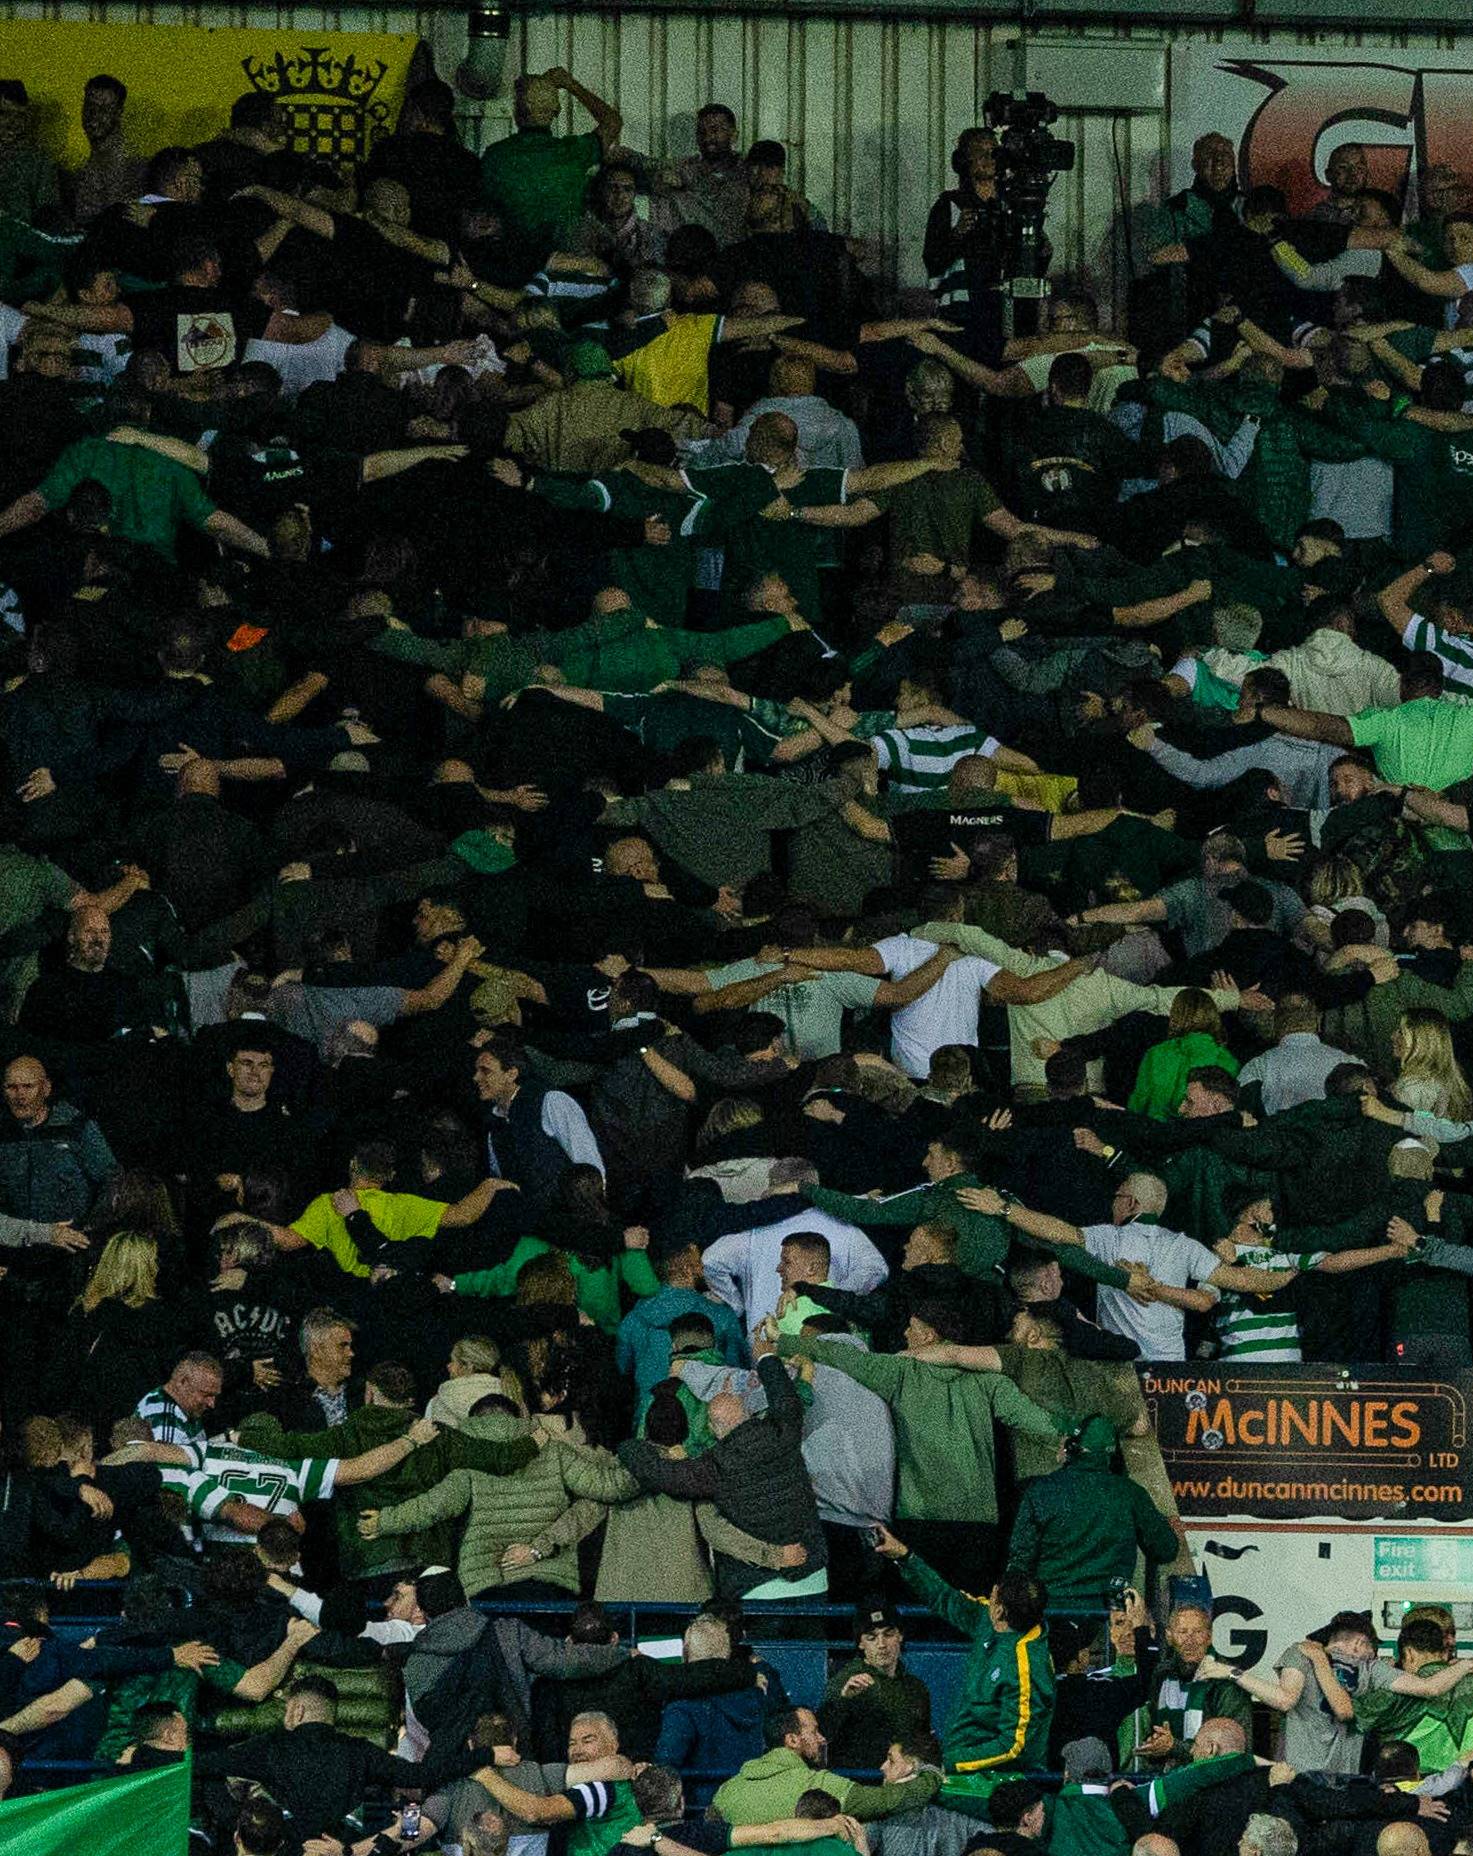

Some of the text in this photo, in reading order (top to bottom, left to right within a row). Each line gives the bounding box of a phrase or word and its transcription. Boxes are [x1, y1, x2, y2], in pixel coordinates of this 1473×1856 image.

[1144, 1380, 1222, 1396] DUNCAN
[1184, 1397, 1421, 1449] McINNES
[1428, 1453, 1459, 1469] LTD
[1172, 1474, 1464, 1508] ww.duncanmcinnes.com
[1211, 1596, 1267, 1671] G
